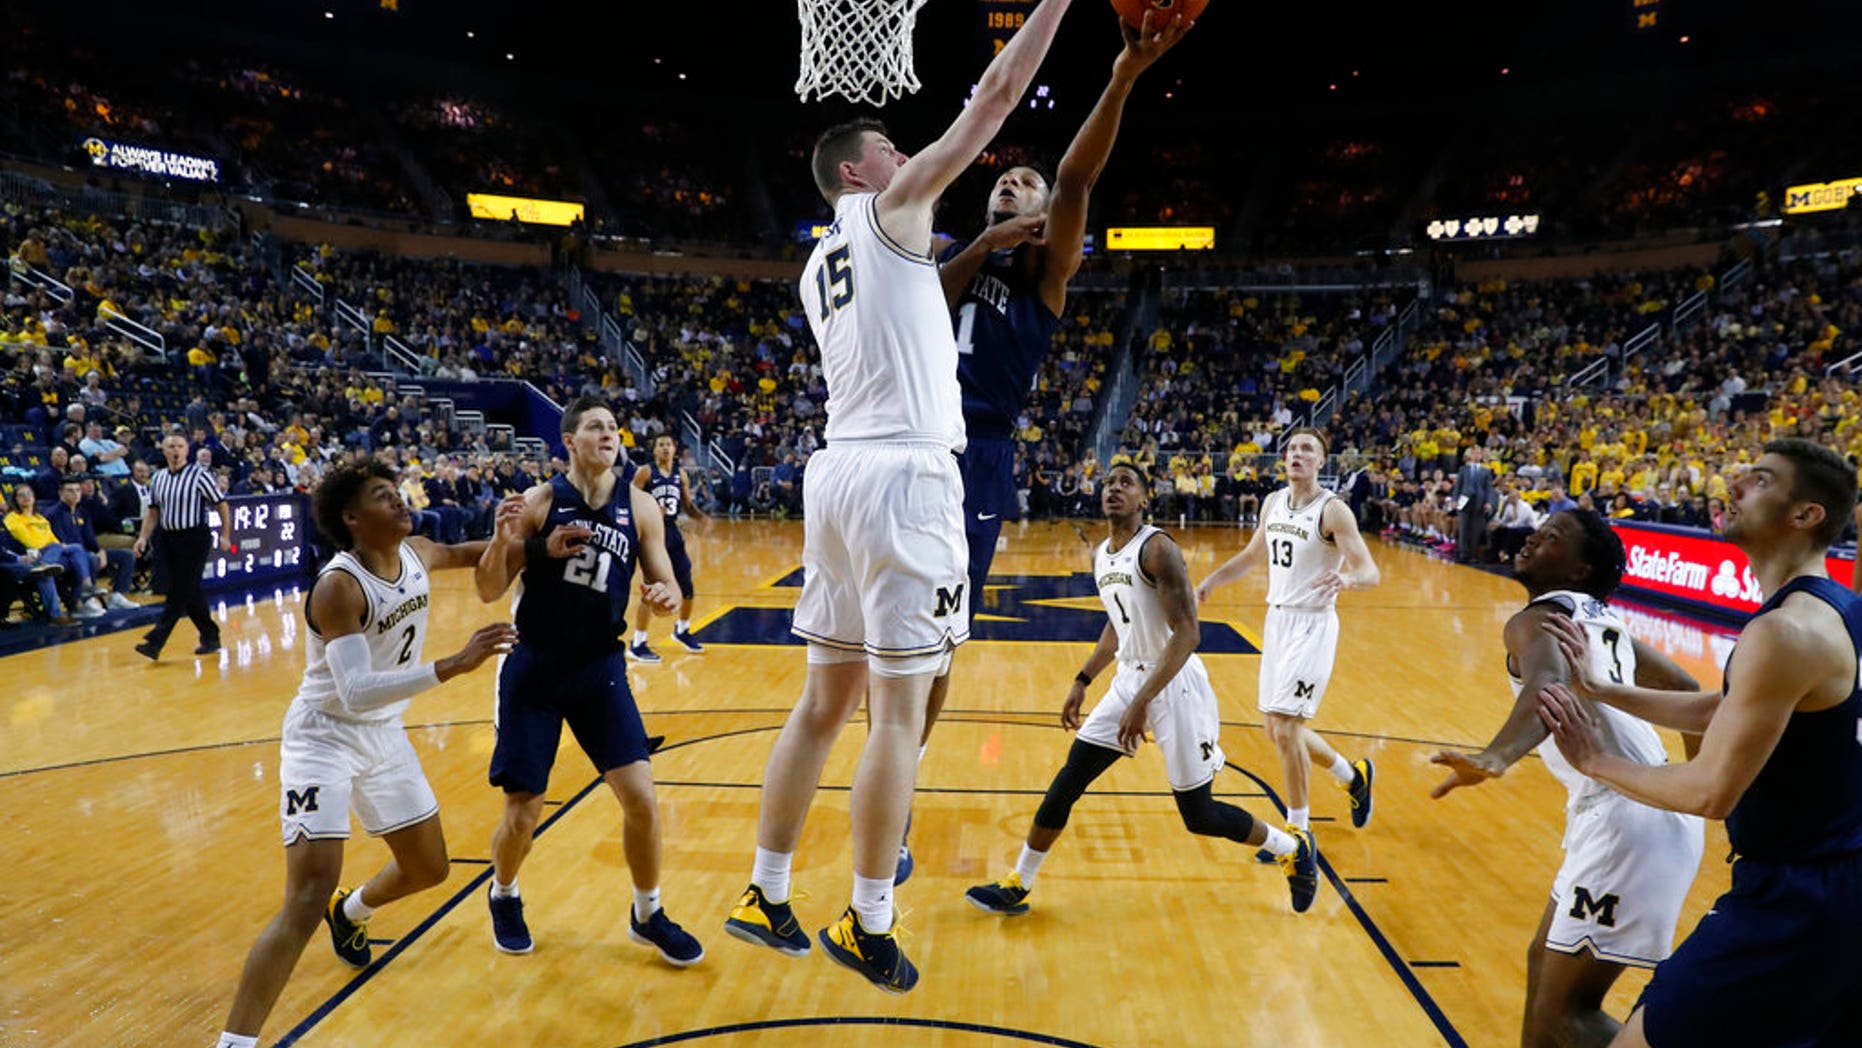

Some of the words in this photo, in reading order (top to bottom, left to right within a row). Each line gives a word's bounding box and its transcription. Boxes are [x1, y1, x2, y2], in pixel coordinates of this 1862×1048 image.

[988, 12, 1025, 28] 1989
[111, 144, 162, 164] ALWAYS
[816, 243, 853, 322] 15
[971, 273, 1010, 315] TATE
[594, 523, 630, 563] STATE
[1271, 538, 1293, 569] 13
[563, 544, 612, 593] 21
[934, 583, 964, 618] M
[1114, 591, 1130, 624] 1
[396, 623, 416, 666] 2
[1602, 627, 1624, 685] 3
[1294, 679, 1315, 699] M
[286, 785, 320, 816] M
[1569, 886, 1619, 928] M
